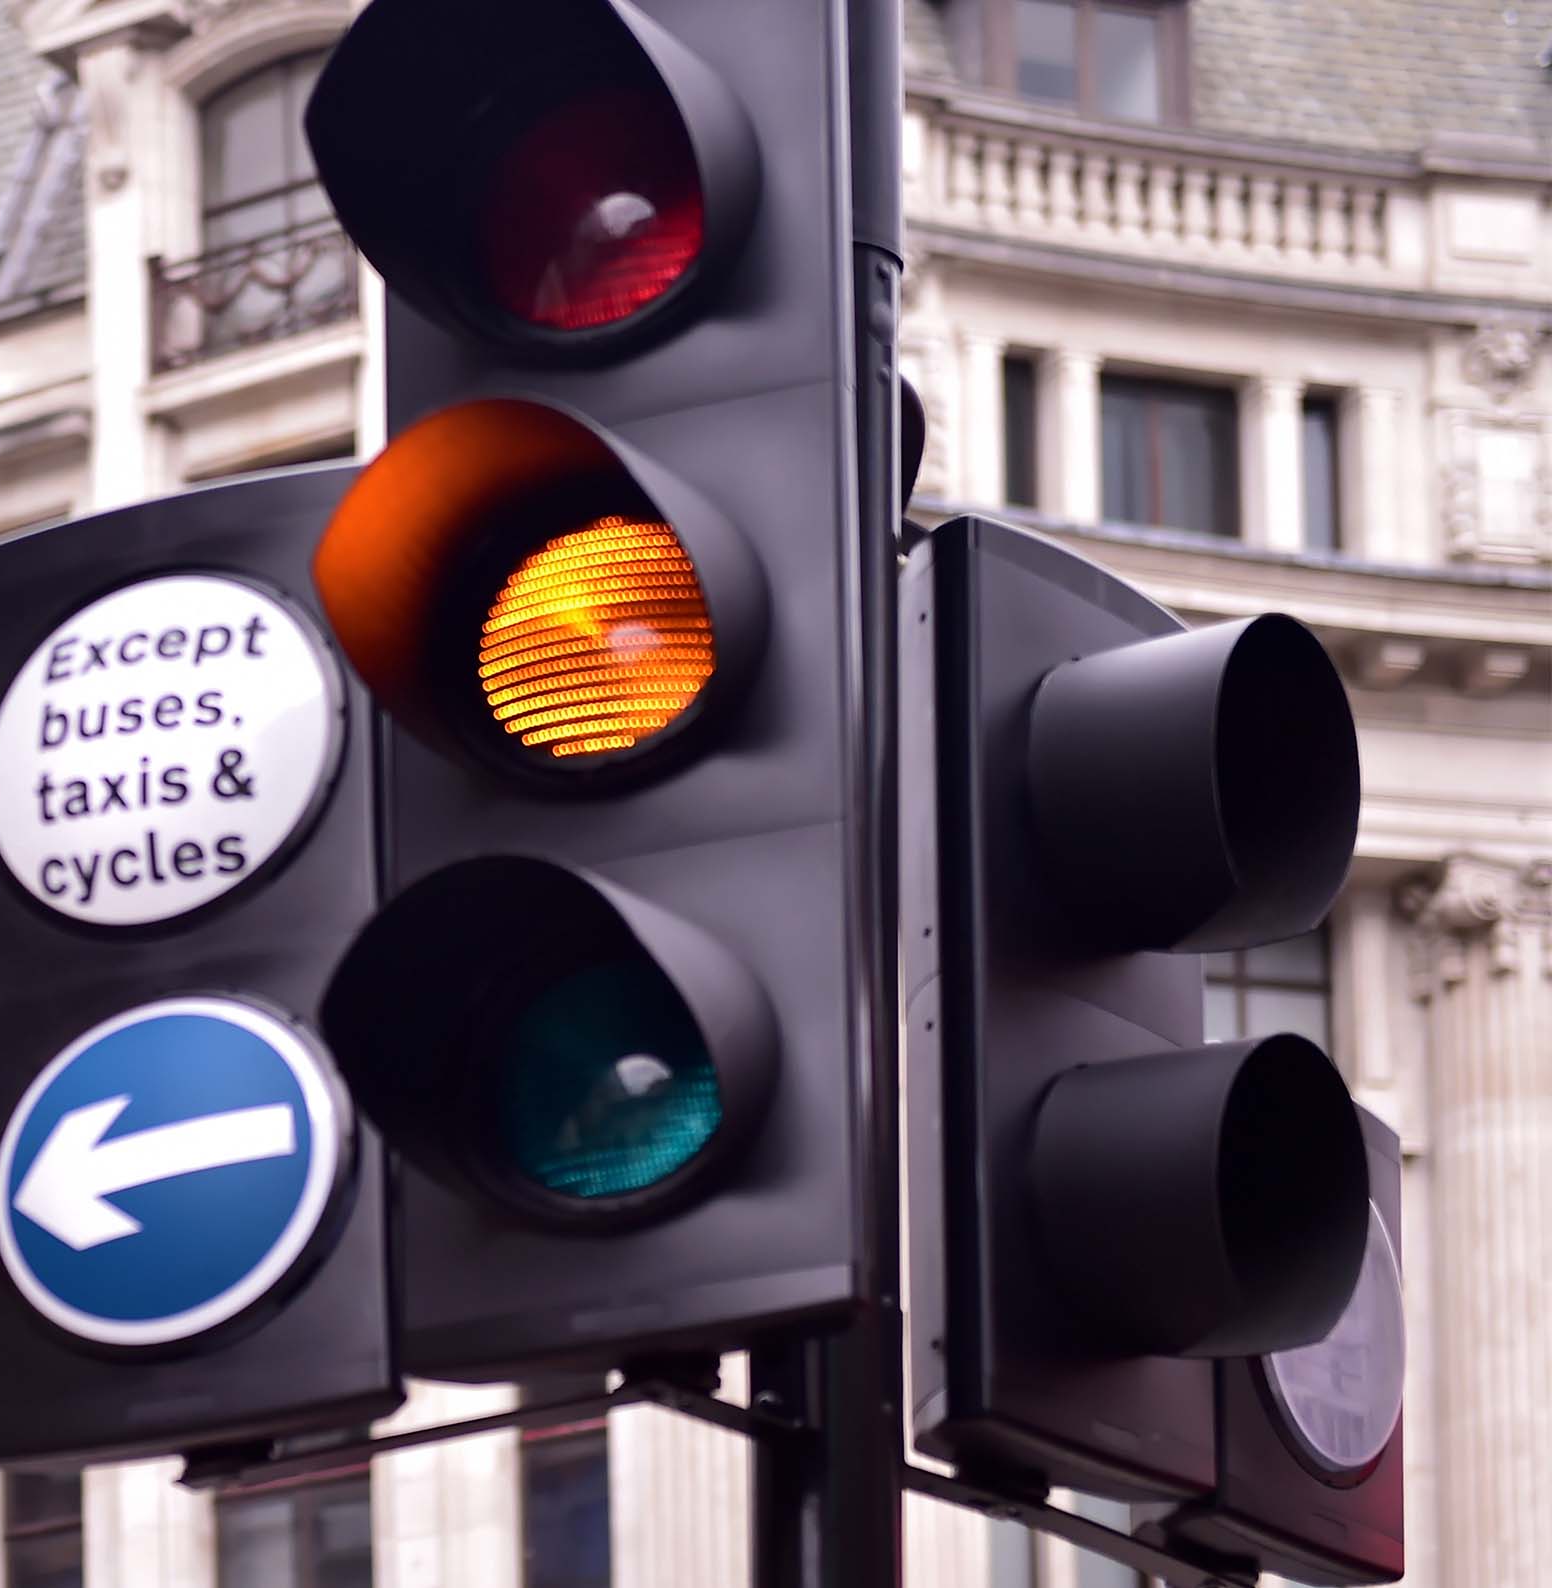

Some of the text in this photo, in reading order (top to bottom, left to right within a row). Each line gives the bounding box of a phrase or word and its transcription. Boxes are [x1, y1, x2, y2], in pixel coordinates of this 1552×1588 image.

[44, 615, 268, 684] Except
[37, 749, 253, 822] taxis &
[42, 830, 246, 903] cycles
